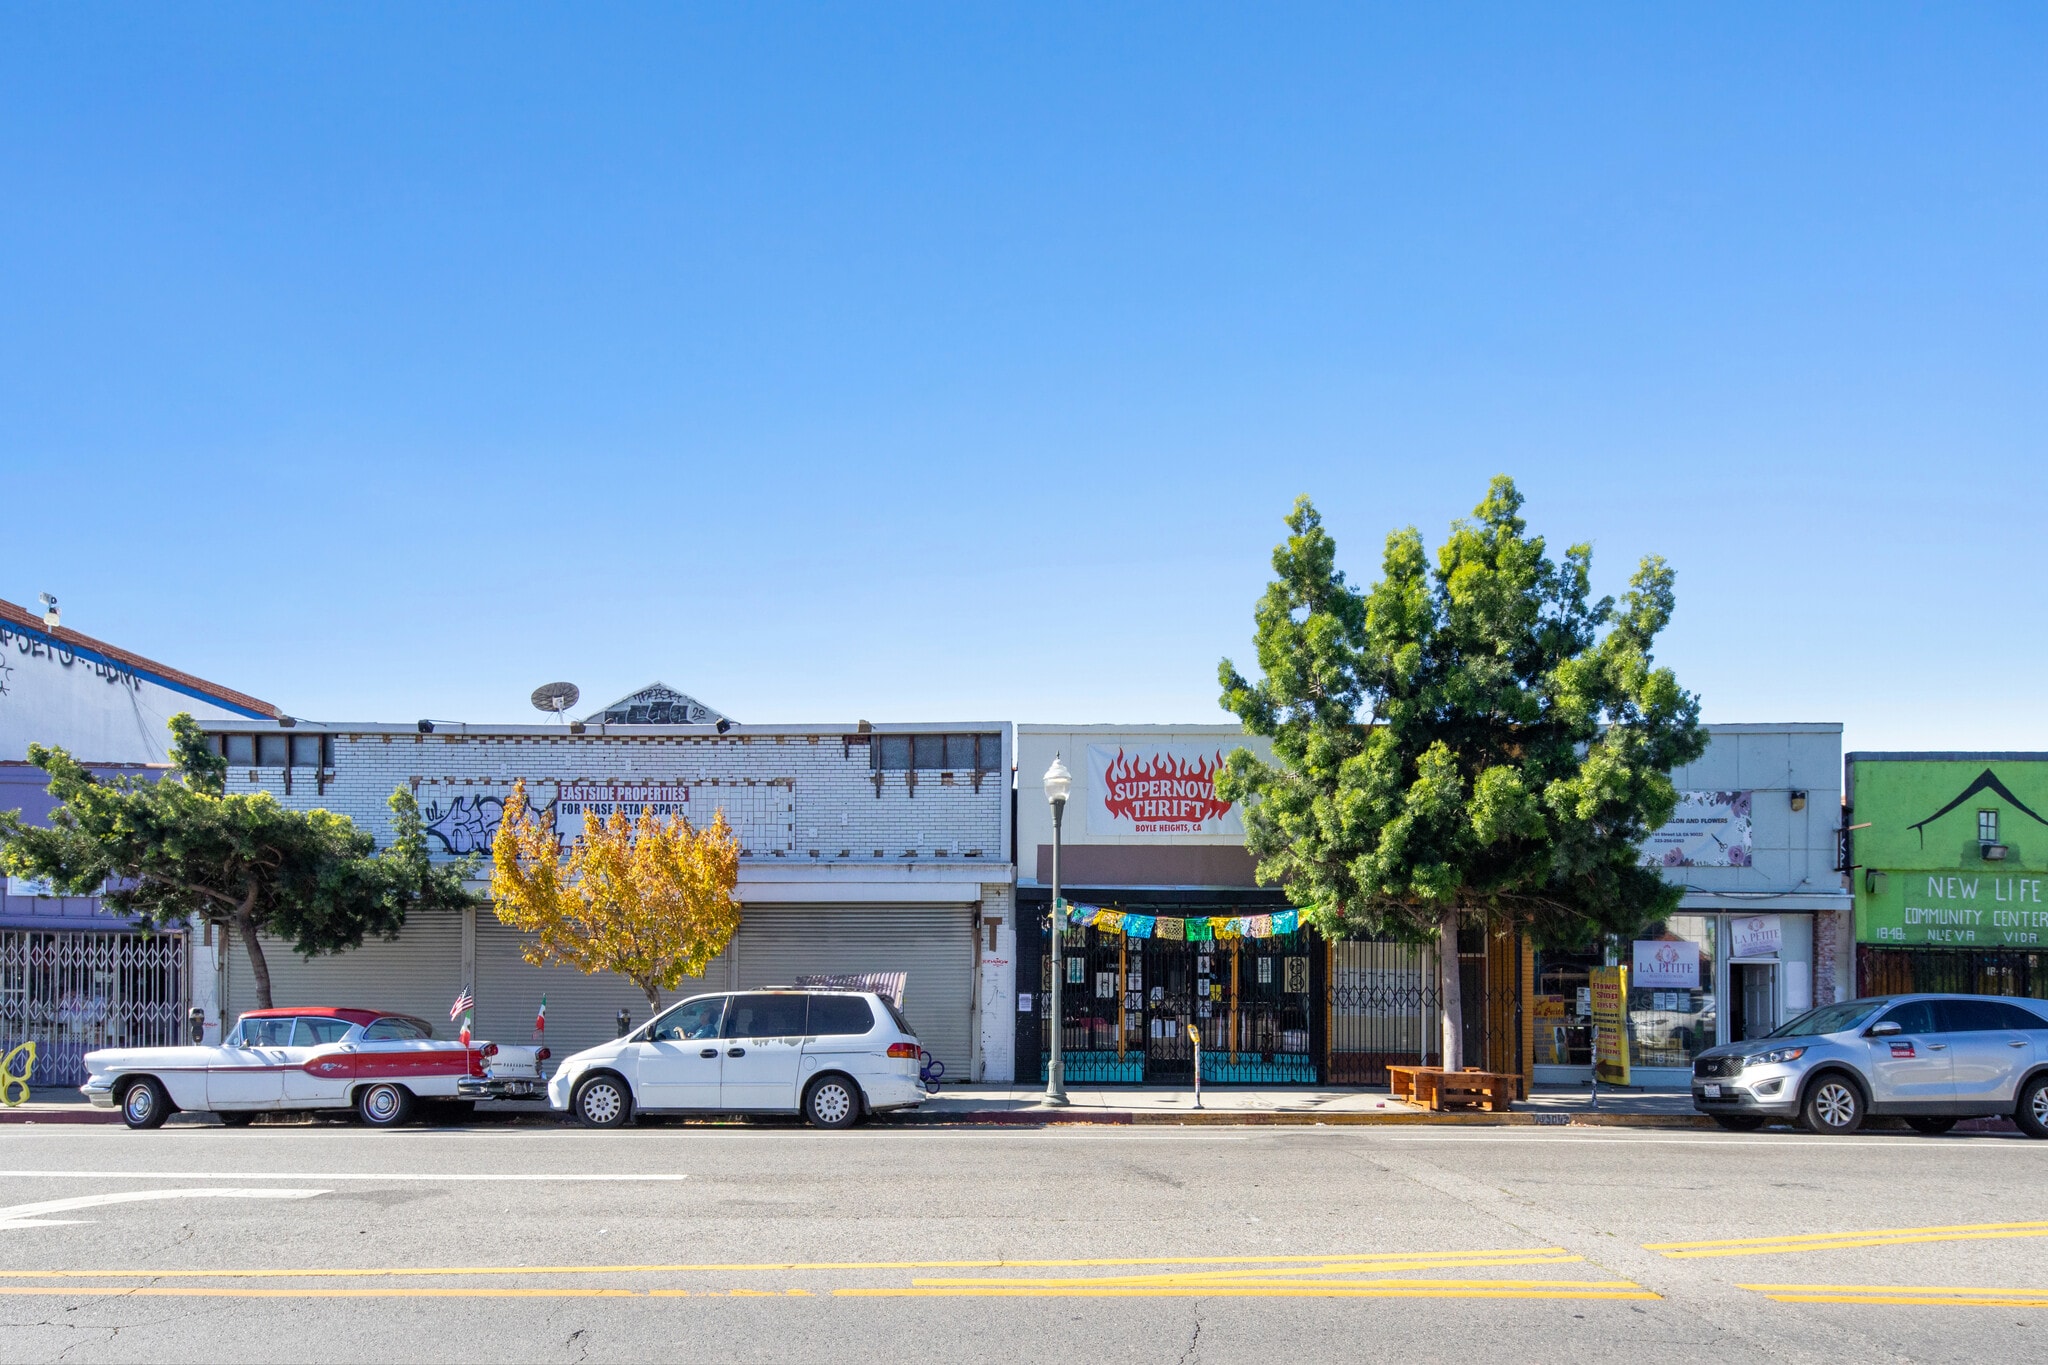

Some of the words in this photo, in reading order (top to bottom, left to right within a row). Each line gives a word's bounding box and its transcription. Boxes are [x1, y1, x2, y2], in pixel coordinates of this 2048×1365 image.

[561, 786, 615, 801] EASTSIDE
[617, 786, 686, 801] PROPERTIES
[561, 803, 580, 815] FOR
[653, 803, 685, 815] SPACE
[1132, 800, 1205, 818] THRIFT
[1135, 824, 1157, 832] BOYLE
[1159, 824, 1190, 833] HEIGHTS,
[1928, 876, 1979, 899] NEW
[1995, 878, 2042, 903] LIFE
[1905, 907, 1983, 925] COMMUNITY
[1993, 910, 2048, 928] CENTER
[2004, 931, 2038, 943] VIDA
[1639, 962, 1655, 973] LA
